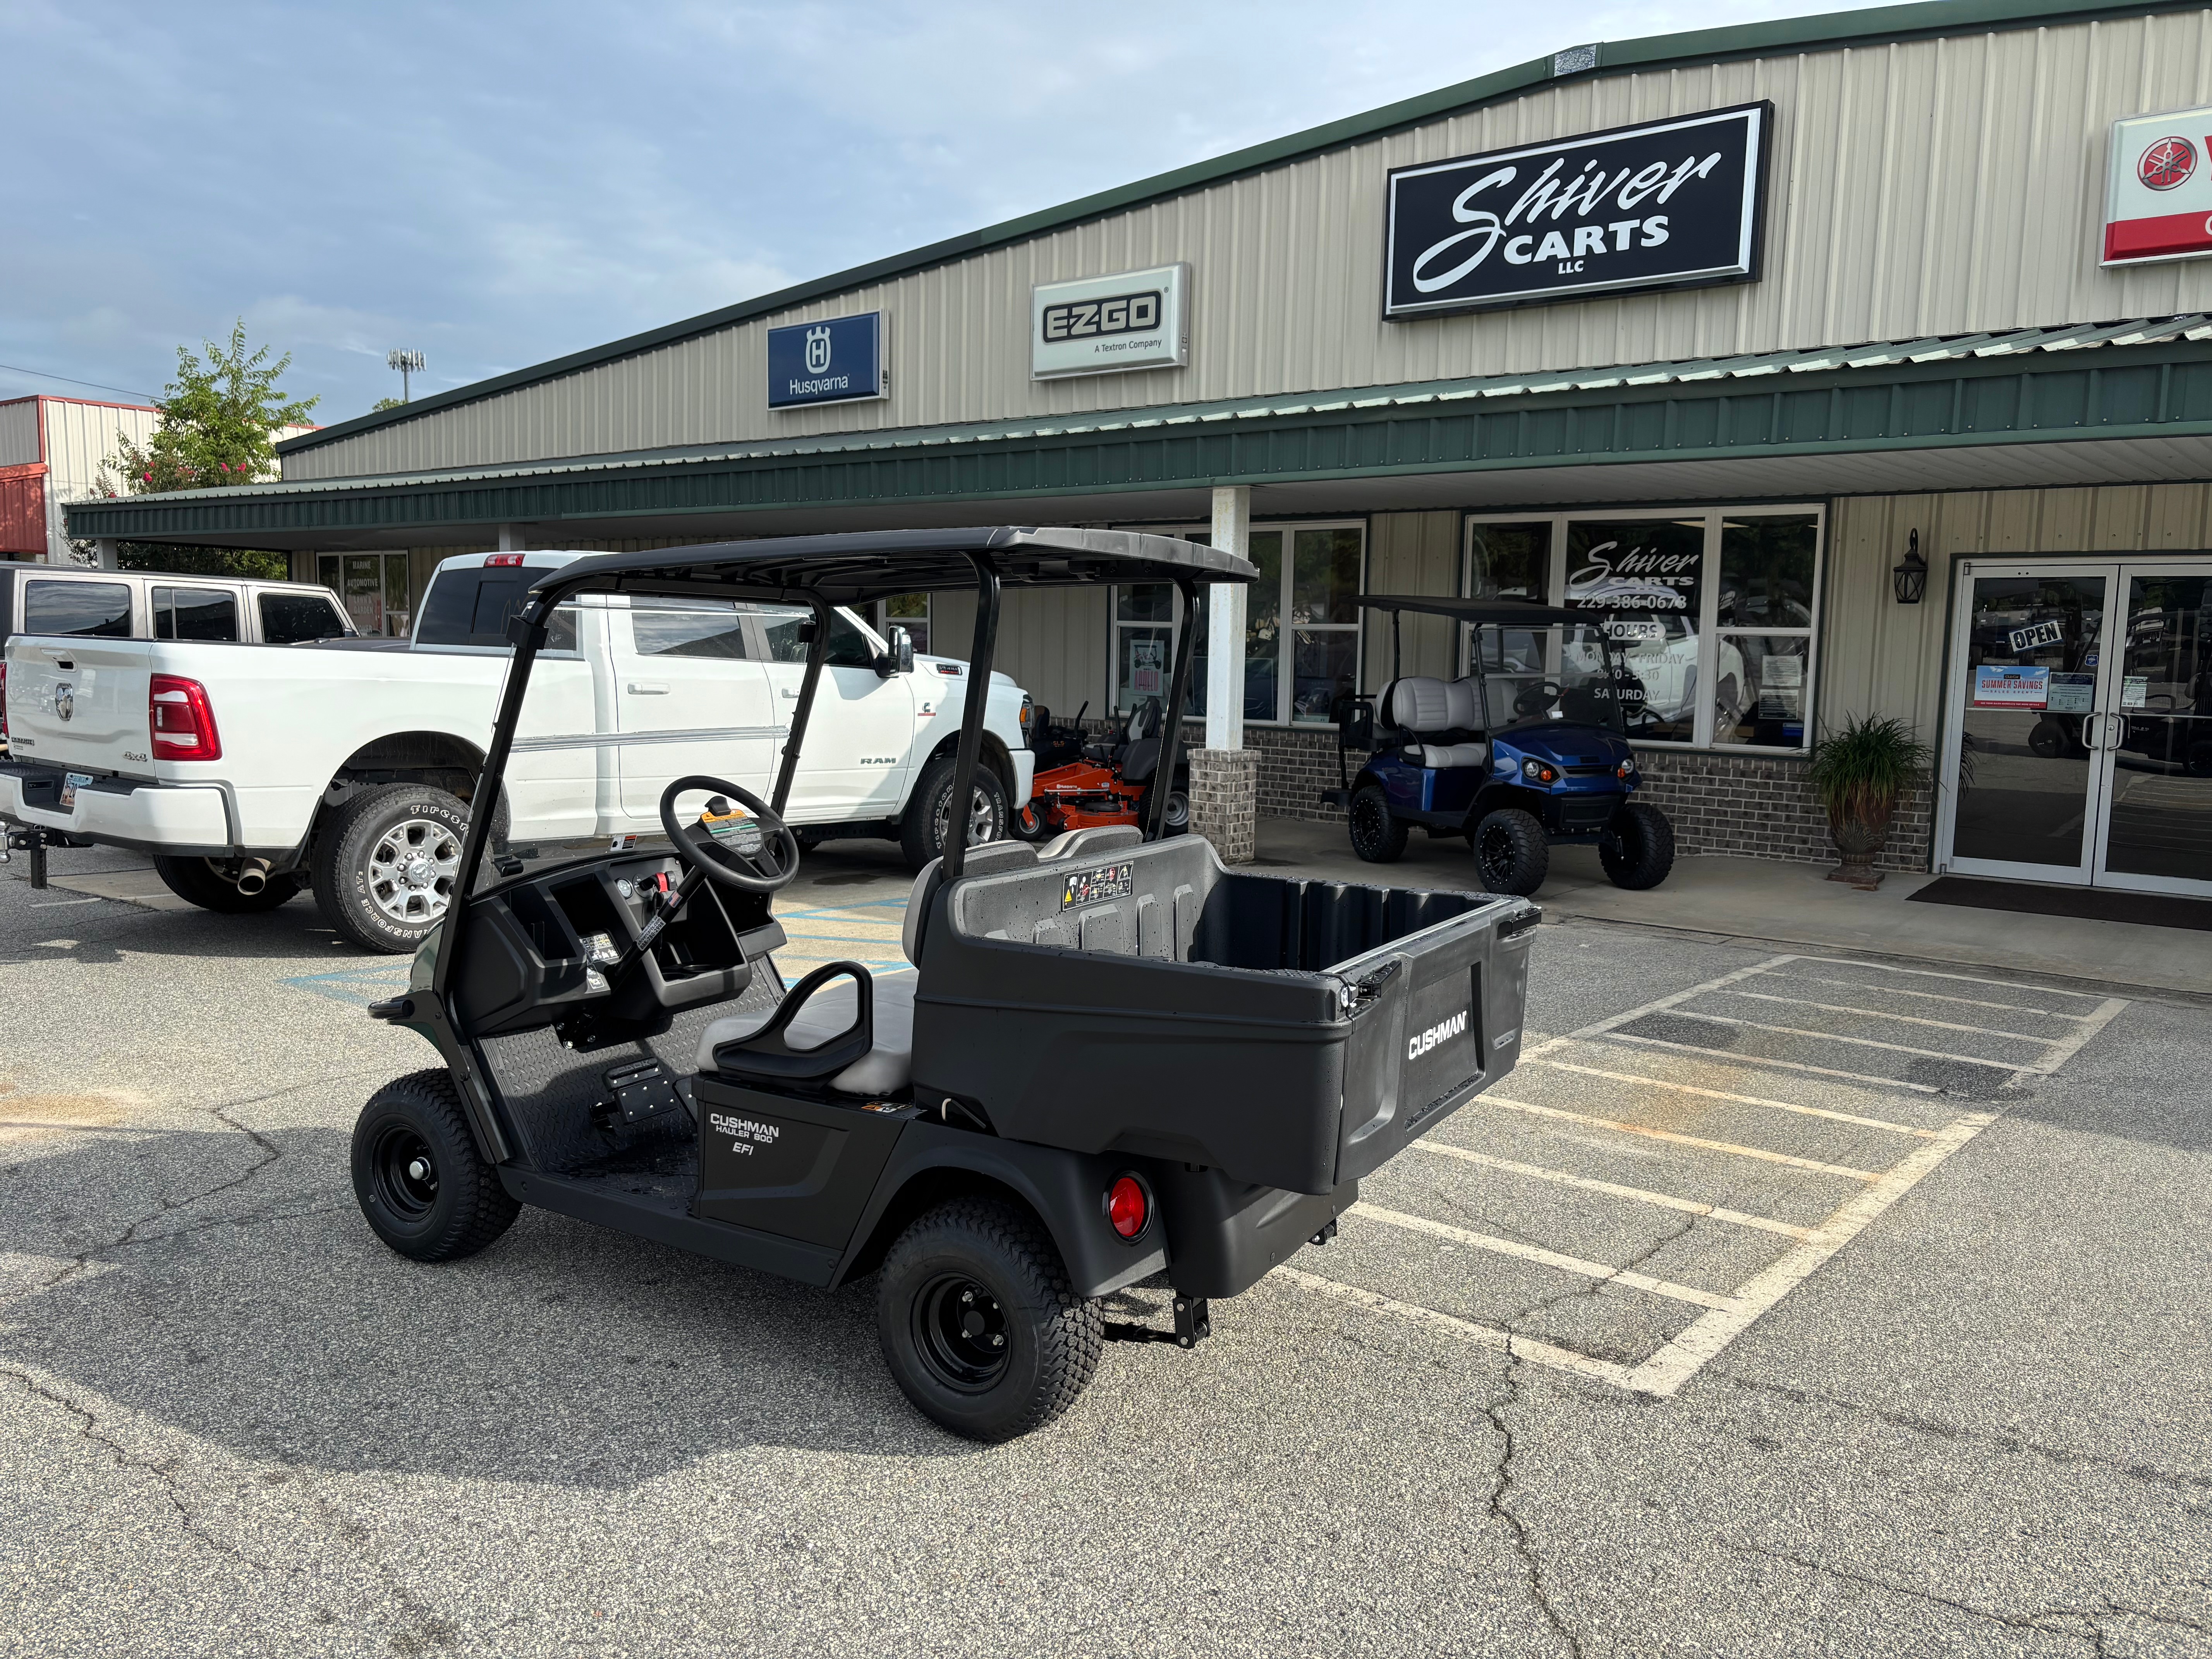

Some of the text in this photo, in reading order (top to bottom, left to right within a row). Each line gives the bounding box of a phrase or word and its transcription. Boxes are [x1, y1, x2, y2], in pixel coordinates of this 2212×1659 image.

[1413, 153, 1721, 292] Shiver
[1504, 216, 1669, 264] CARTS
[1558, 260, 1584, 275] LLC
[1047, 296, 1156, 338] EZGO
[1102, 343, 1126, 352] Textron
[1129, 339, 1162, 349] Company
[790, 376, 848, 395] Husqvarna
[353, 561, 371, 570] MARINE
[1570, 541, 1699, 590] Shiver
[347, 578, 378, 587] AUTOMOTIVE
[1609, 577, 1694, 586] CARTS
[354, 595, 367, 605] LAWN
[1577, 595, 1686, 609] 229-386-0678
[354, 605, 373, 615] GARDEN
[2013, 622, 2058, 649] OPEN
[1639, 653, 1685, 664] FRIDAY
[1597, 670, 1622, 680] 8:0
[1632, 671, 1659, 680] 5:30
[1982, 680, 2043, 689] SUMMER SAVINGS
[1594, 688, 1660, 701] SAURDAY
[994, 792, 1004, 841] TRANSFO
[640, 921, 664, 949] 888-780-2998
[1408, 1011, 1466, 1060] CUSHMAN
[711, 1113, 779, 1137] CUSHMAN
[716, 1125, 773, 1143] HAULER 800
[733, 1142, 754, 1156] EFI
